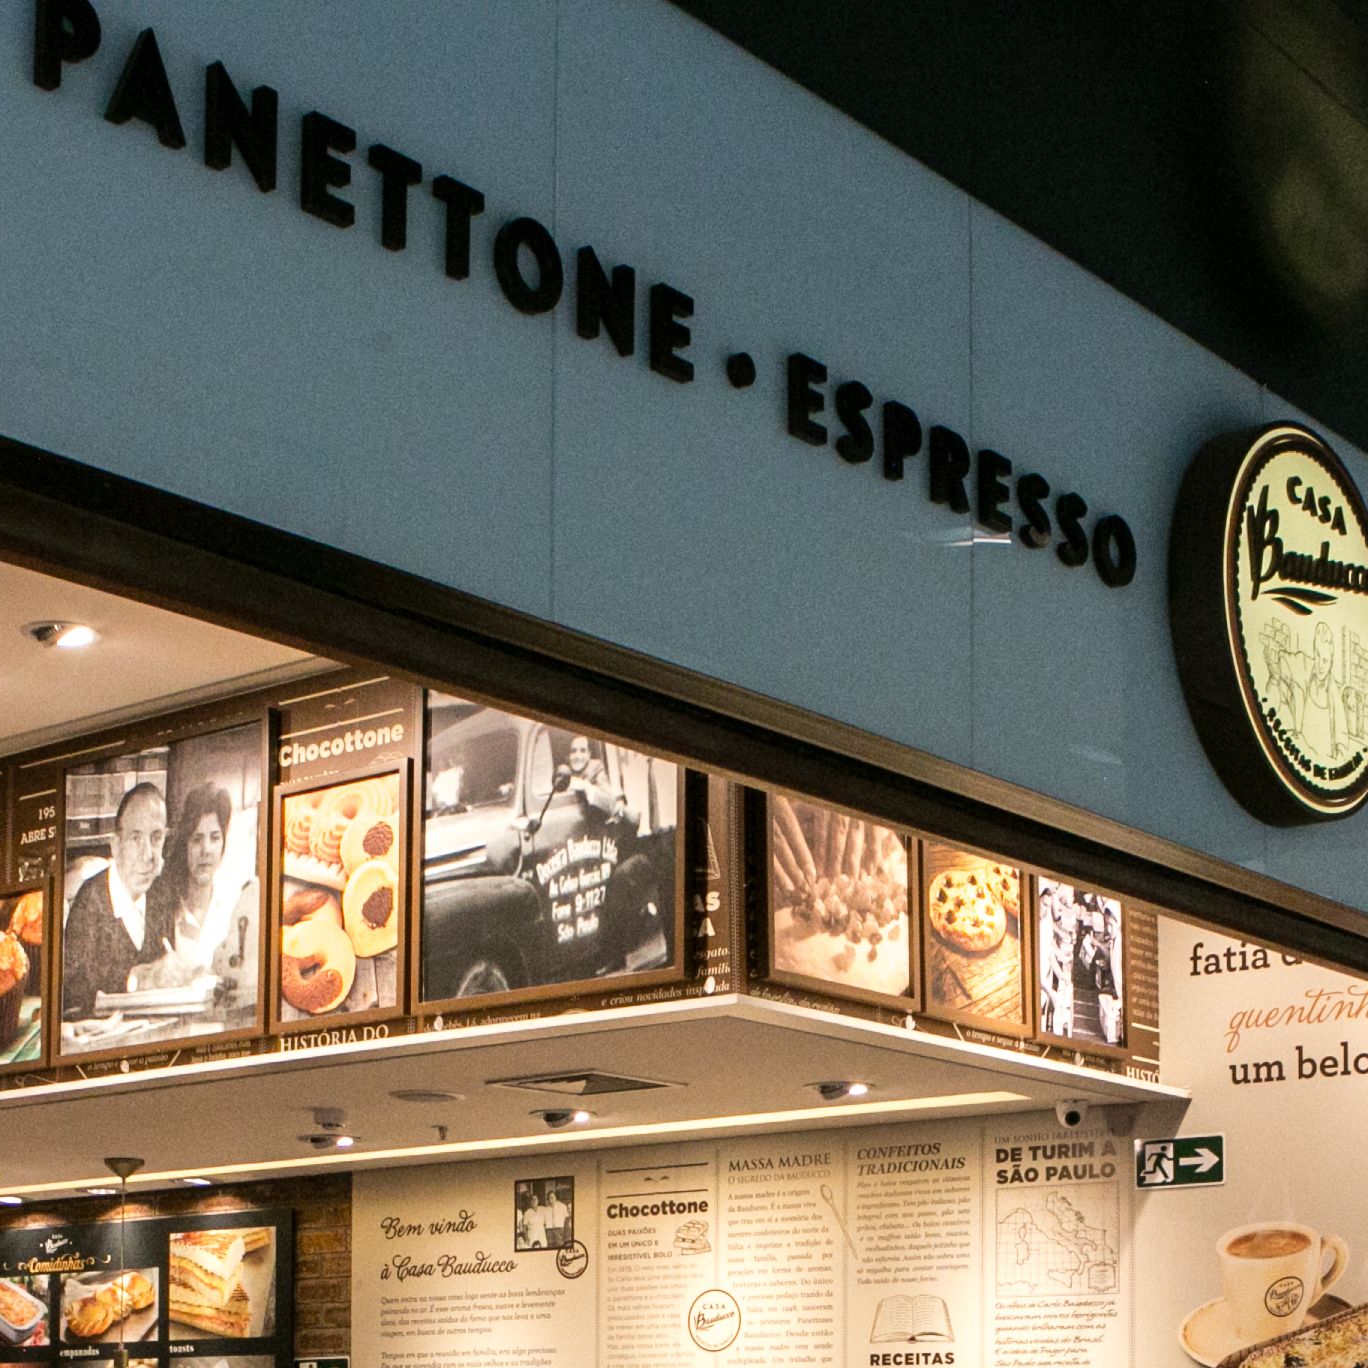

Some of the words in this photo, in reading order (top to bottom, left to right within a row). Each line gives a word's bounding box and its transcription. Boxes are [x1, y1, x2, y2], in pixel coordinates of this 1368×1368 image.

[33, 0, 695, 383] PANETTONE
[788, 352, 1137, 588] ESPRESSO
[1287, 475, 1347, 536] CASA
[280, 722, 405, 768] Chocottone
[20, 828, 46, 845] ABRE
[1190, 943, 1270, 977] fatia
[280, 1026, 358, 1053] HISTÓRIA
[362, 1024, 389, 1041] DO
[1229, 1059, 1286, 1086] um
[857, 1142, 942, 1161] CONFEITOS
[995, 1147, 1023, 1163] DE
[1028, 1142, 1095, 1162] TURIM
[1101, 1140, 1118, 1156] A
[728, 1158, 774, 1172] MASSA
[778, 1153, 831, 1170] MADRE
[857, 1157, 966, 1176] TRADICIONAIS
[737, 1173, 772, 1184] SEGREDO
[774, 1173, 785, 1182] DA
[787, 1169, 831, 1182] BAUDUCCO
[996, 1164, 1039, 1184] SÃO
[1045, 1162, 1116, 1182] PAULO
[607, 1200, 708, 1219] Chocottone
[381, 1216, 425, 1240] Bem
[429, 1209, 479, 1236] vindo
[608, 1228, 626, 1238] DUAS
[627, 1227, 657, 1236] PAIXÕES
[654, 1239, 659, 1247] E
[653, 1251, 673, 1259] BOLO
[381, 1263, 391, 1280] à
[392, 1253, 436, 1282] Casa
[437, 1250, 518, 1279] Bauducco
[59, 1347, 100, 1359] empanadas
[169, 1344, 195, 1354] toasts
[870, 1352, 955, 1366] RECEITAS
